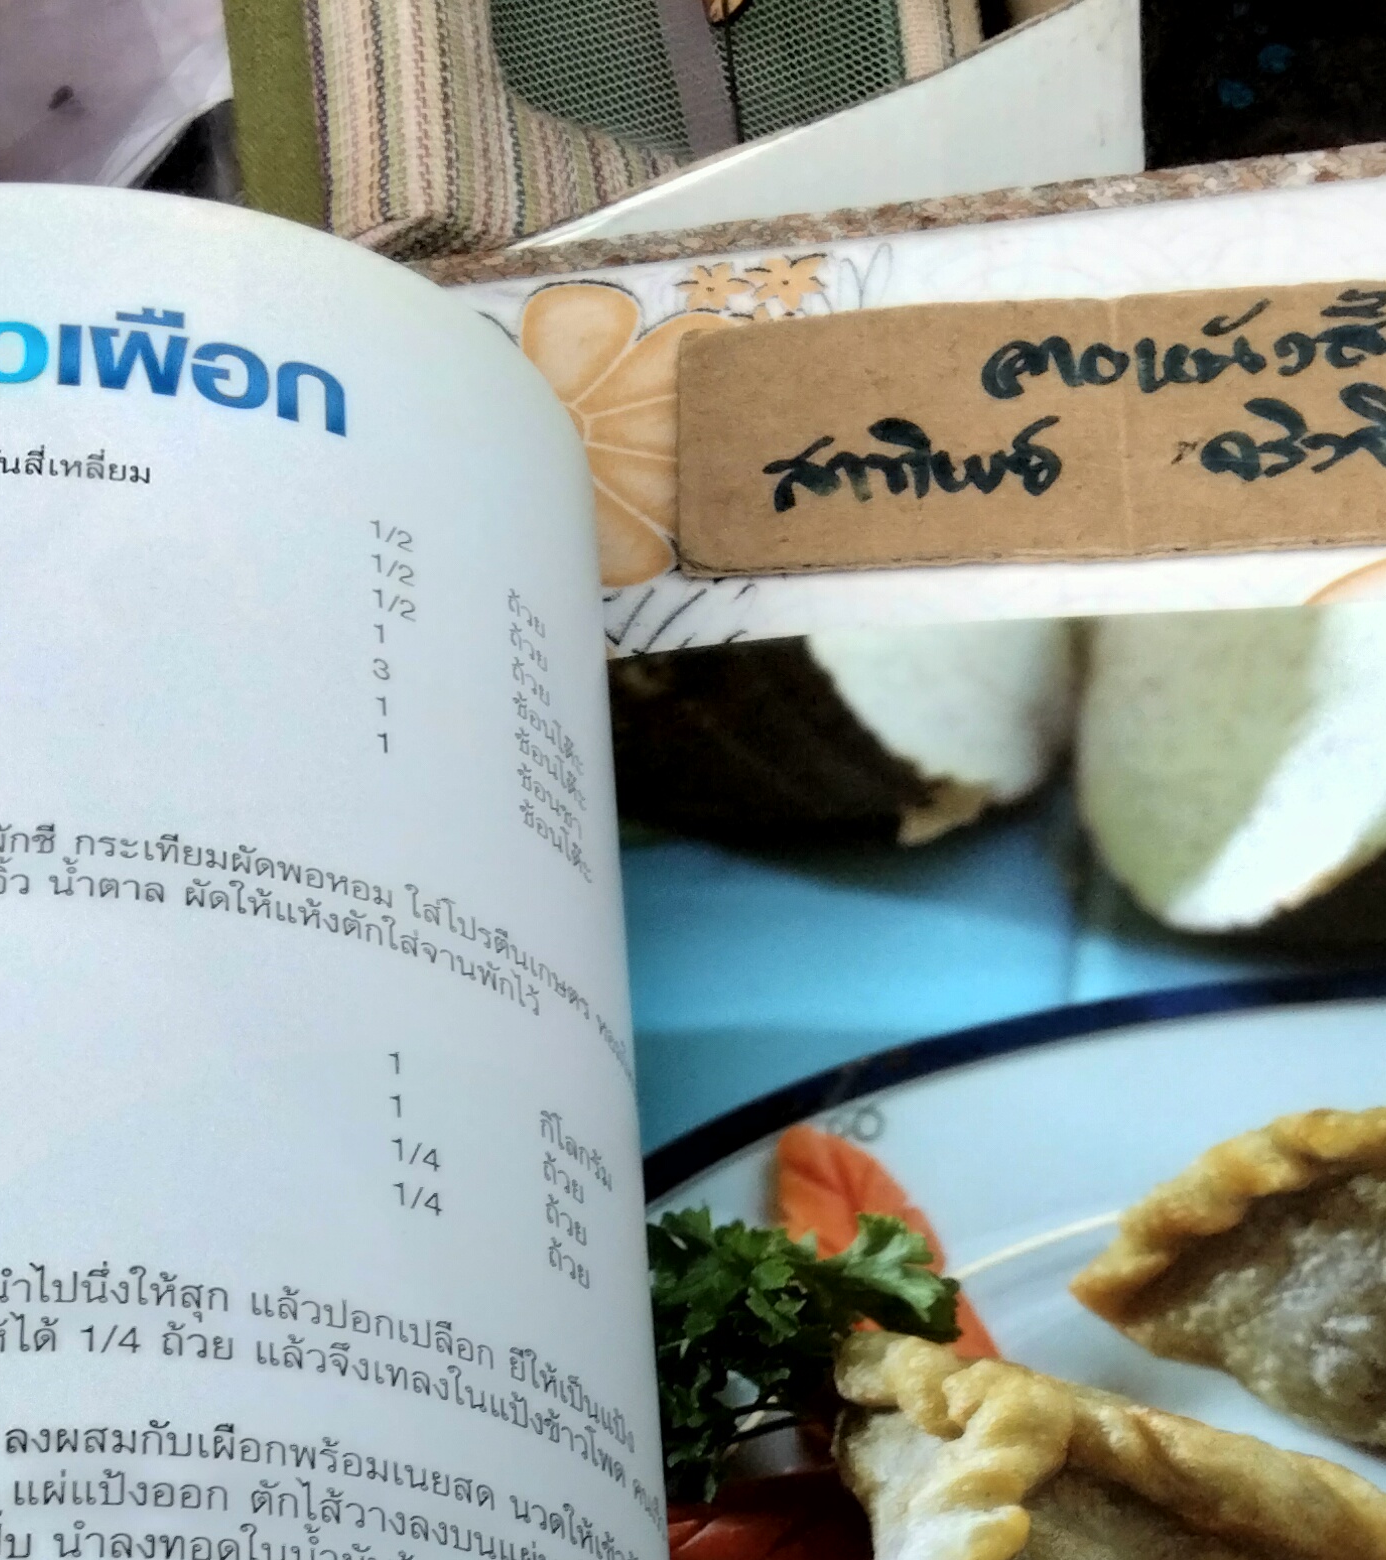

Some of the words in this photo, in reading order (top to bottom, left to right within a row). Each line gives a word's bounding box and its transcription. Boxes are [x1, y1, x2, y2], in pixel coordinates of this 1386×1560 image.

[369, 520, 414, 552] 1/2
[371, 553, 415, 587] 1/2
[372, 588, 417, 622] 1/2
[373, 624, 386, 644] 1
[372, 658, 390, 681] 3
[376, 695, 388, 717] 1
[376, 732, 389, 753] 1
[49, 857, 166, 903] น้ำตาล
[74, 832, 393, 909] กระเทียมผัดพอหอม
[388, 1051, 401, 1075] 1
[389, 1094, 402, 1118] 1
[543, 1151, 585, 1204] ถ้วย
[391, 1138, 441, 1172] 1/4
[545, 1194, 588, 1247] ถ้วย
[393, 1182, 443, 1217] 1/4
[548, 1237, 591, 1290] ถ้วย
[80, 1325, 142, 1354] 1/4
[162, 1319, 234, 1362] ถ้วย
[250, 1285, 495, 1372] แล้วปอกเปลือก
[4, 1419, 497, 1511] ลงผสมกับเผือกพร้อมเนยสด
[14, 1468, 229, 1511] แผ่แป้งออก
